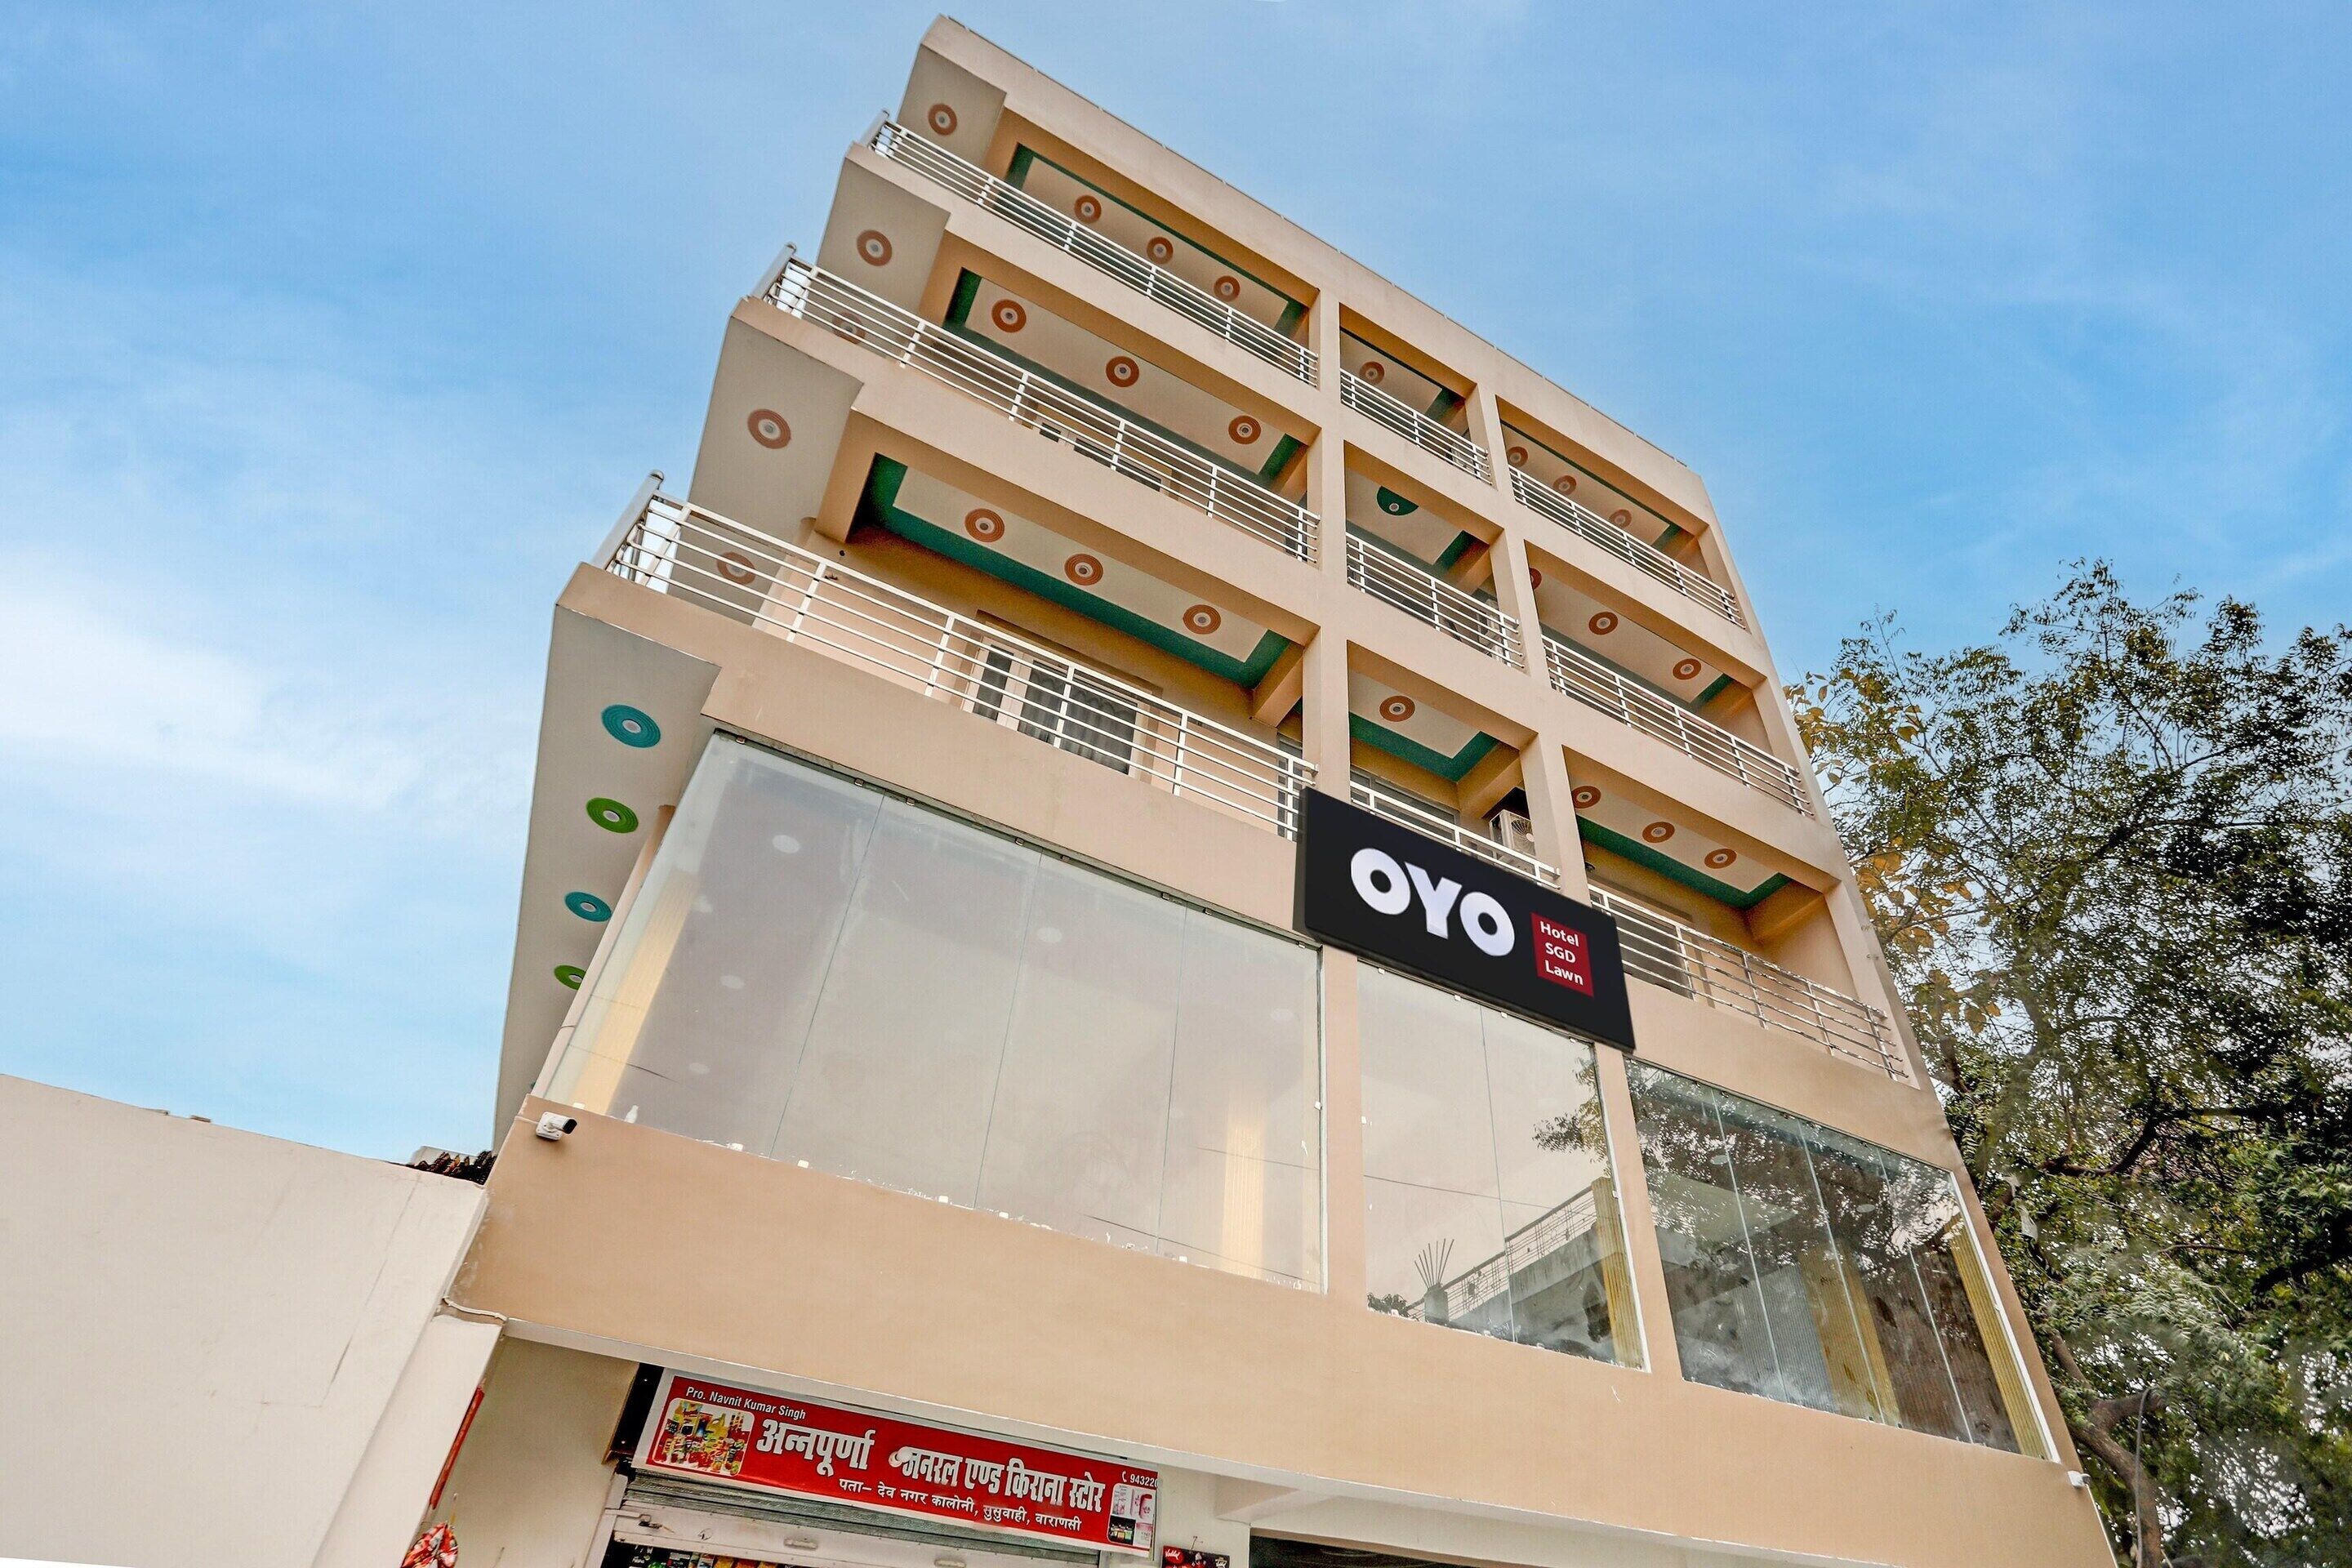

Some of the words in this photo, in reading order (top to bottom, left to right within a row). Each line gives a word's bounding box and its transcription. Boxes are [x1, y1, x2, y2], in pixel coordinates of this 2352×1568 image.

[1351, 848, 1515, 956] OYO
[1540, 920, 1579, 947] Hotel
[1545, 942, 1576, 964] SGD
[1544, 959, 1584, 986] Lawn
[686, 1387, 706, 1400] Pro.
[710, 1391, 742, 1406] Navnit
[744, 1398, 777, 1414] Kumar
[778, 1405, 806, 1420] Singh
[756, 1419, 876, 1477] अन्नपूर्णा
[964, 1458, 1004, 1494] एण्ड
[1004, 1458, 1067, 1506] किराना
[1069, 1472, 1106, 1512] स्टोर
[877, 1481, 896, 1499] देव
[900, 1489, 929, 1504] नगर
[1035, 1512, 1082, 1531] वाराणसी
